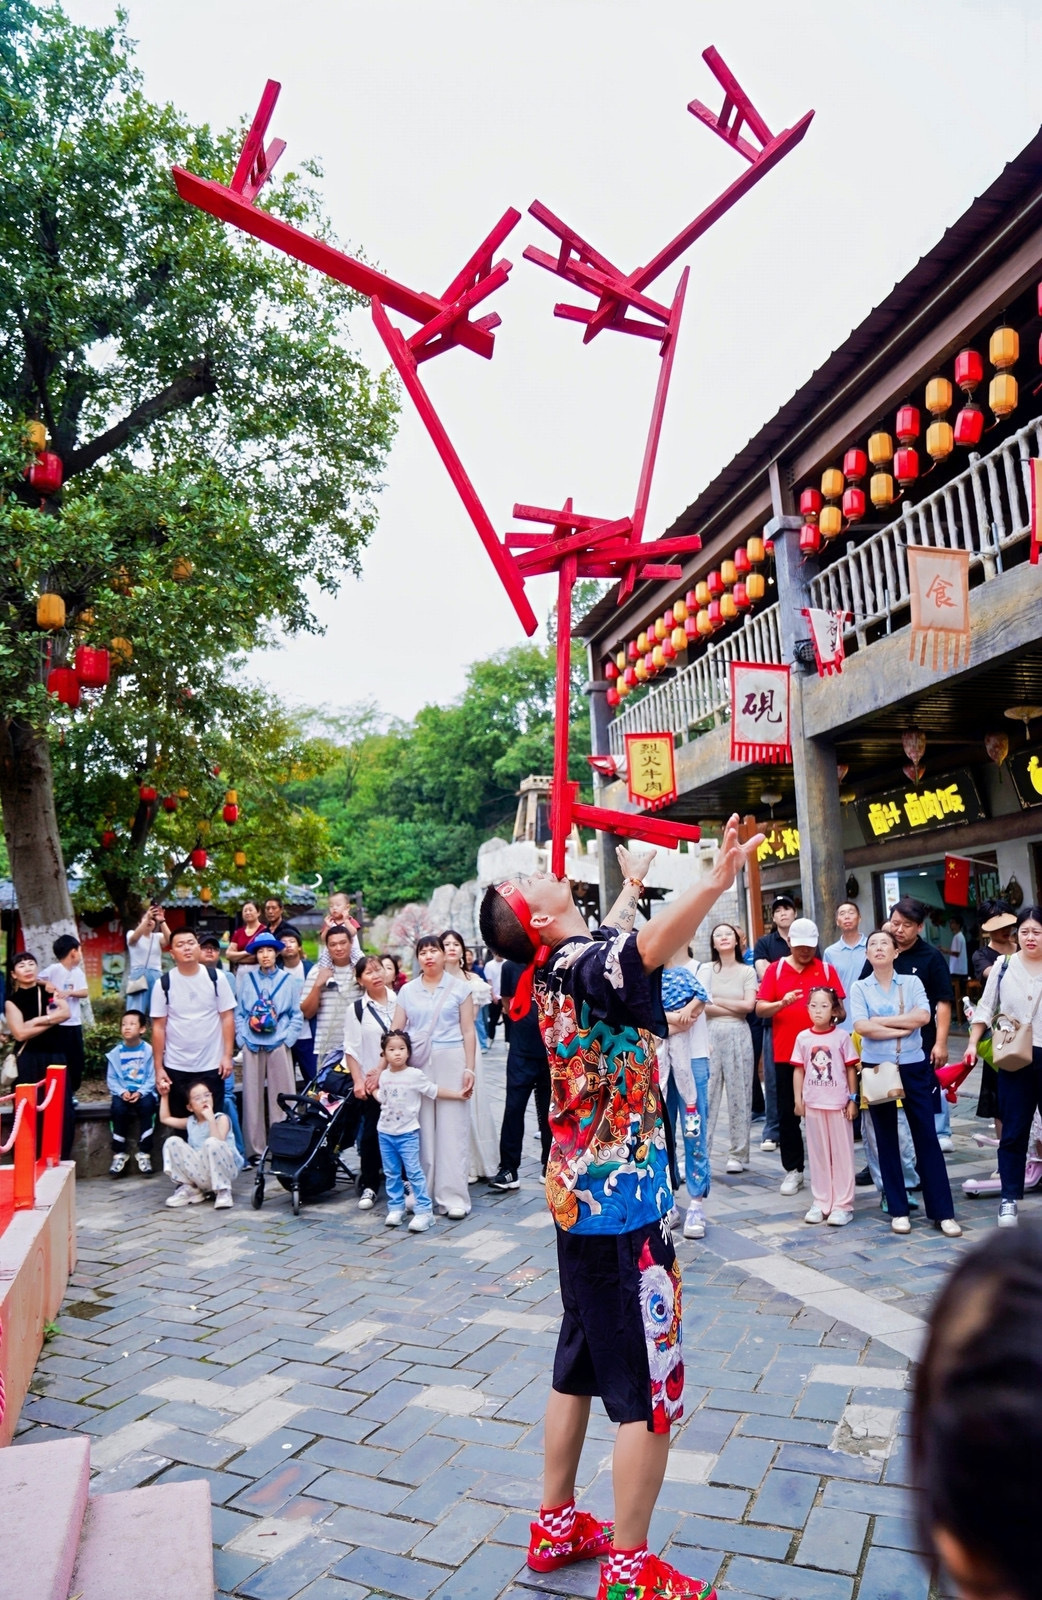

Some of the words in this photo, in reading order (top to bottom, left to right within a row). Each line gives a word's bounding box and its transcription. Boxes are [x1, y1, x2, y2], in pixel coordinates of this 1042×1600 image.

[925, 574, 959, 608] 食
[640, 743, 662, 792] 烈火牛肉
[904, 784, 965, 827] 卤肉饭
